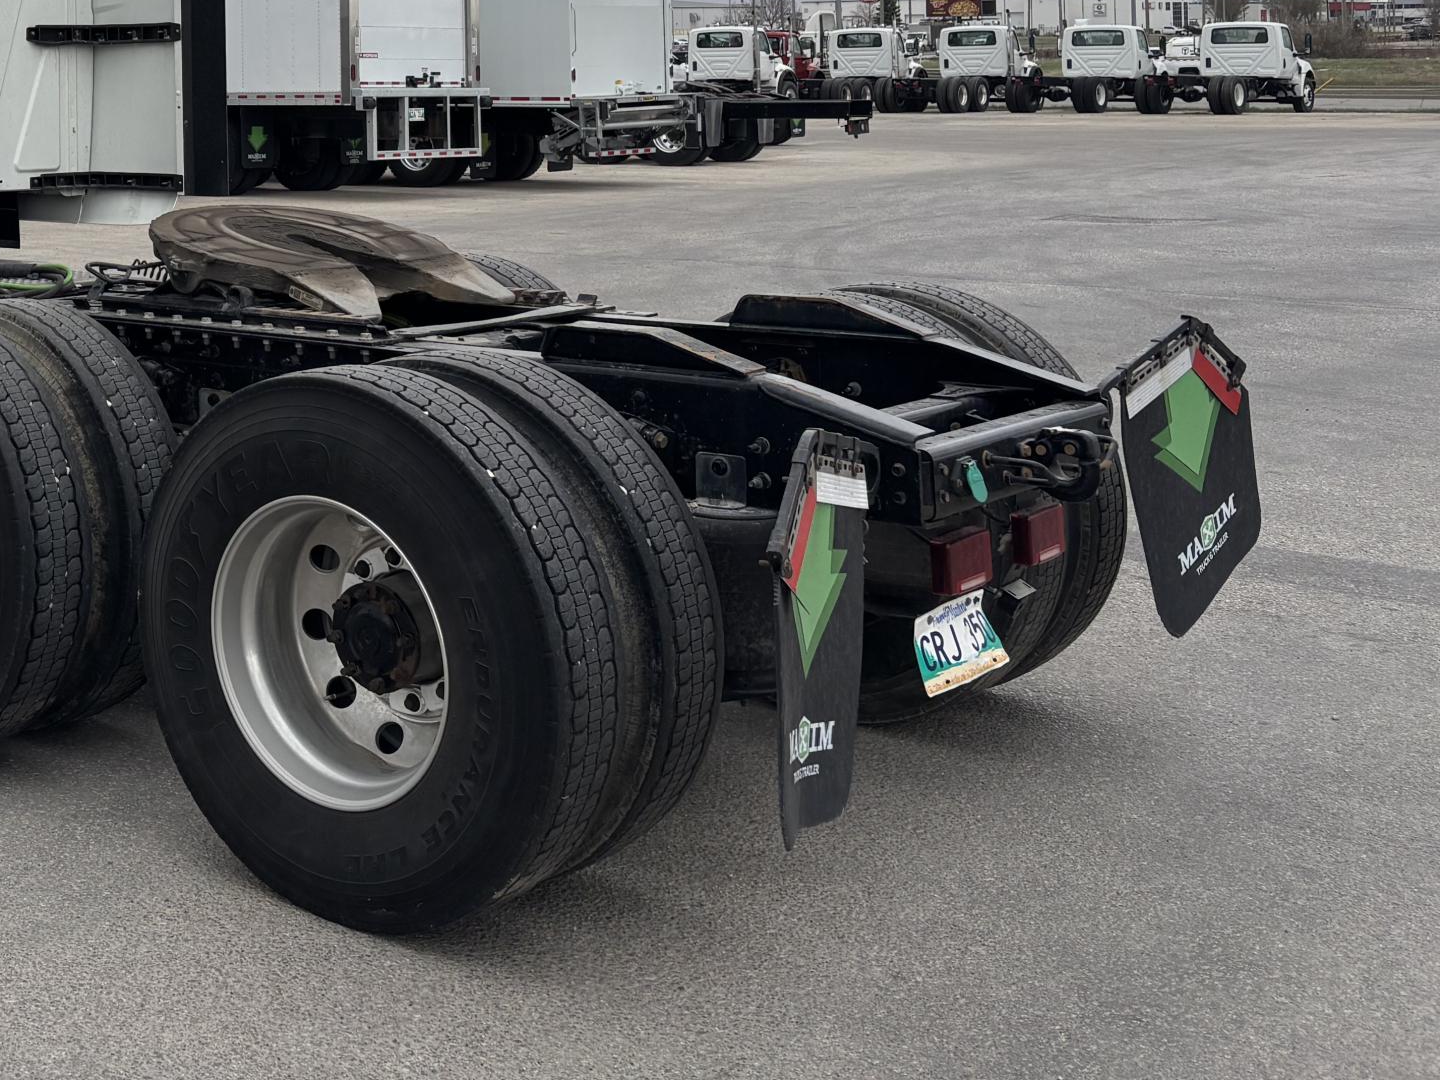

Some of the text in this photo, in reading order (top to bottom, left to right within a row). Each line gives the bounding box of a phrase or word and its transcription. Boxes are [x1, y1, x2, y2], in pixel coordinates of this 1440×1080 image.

[1177, 492, 1237, 576] MAXIM
[1212, 531, 1229, 556] TRAILER
[920, 609, 996, 672] CRJ 350
[789, 715, 835, 766] MAXIM
